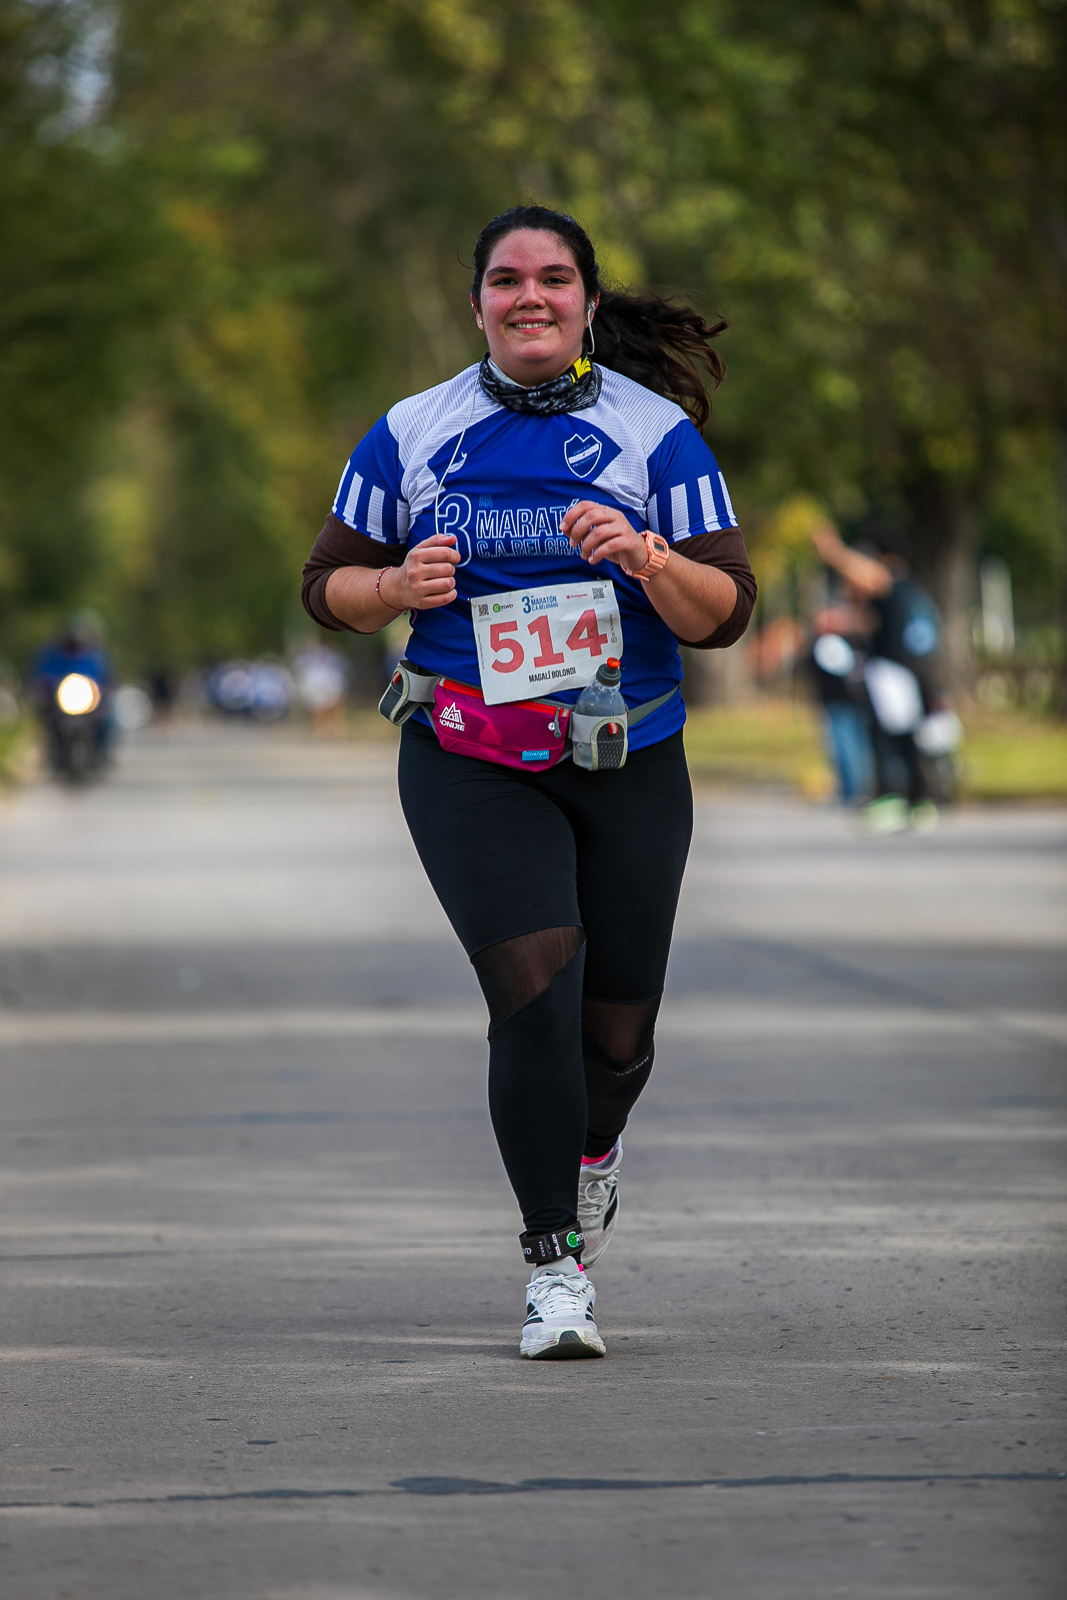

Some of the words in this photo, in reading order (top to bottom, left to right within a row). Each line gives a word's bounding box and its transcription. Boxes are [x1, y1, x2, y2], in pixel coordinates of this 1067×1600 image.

[437, 493, 472, 568] 3
[476, 499, 583, 540] MARAT
[521, 595, 532, 614] 3
[490, 609, 608, 673] 514
[528, 670, 551, 683] MAGALÍ
